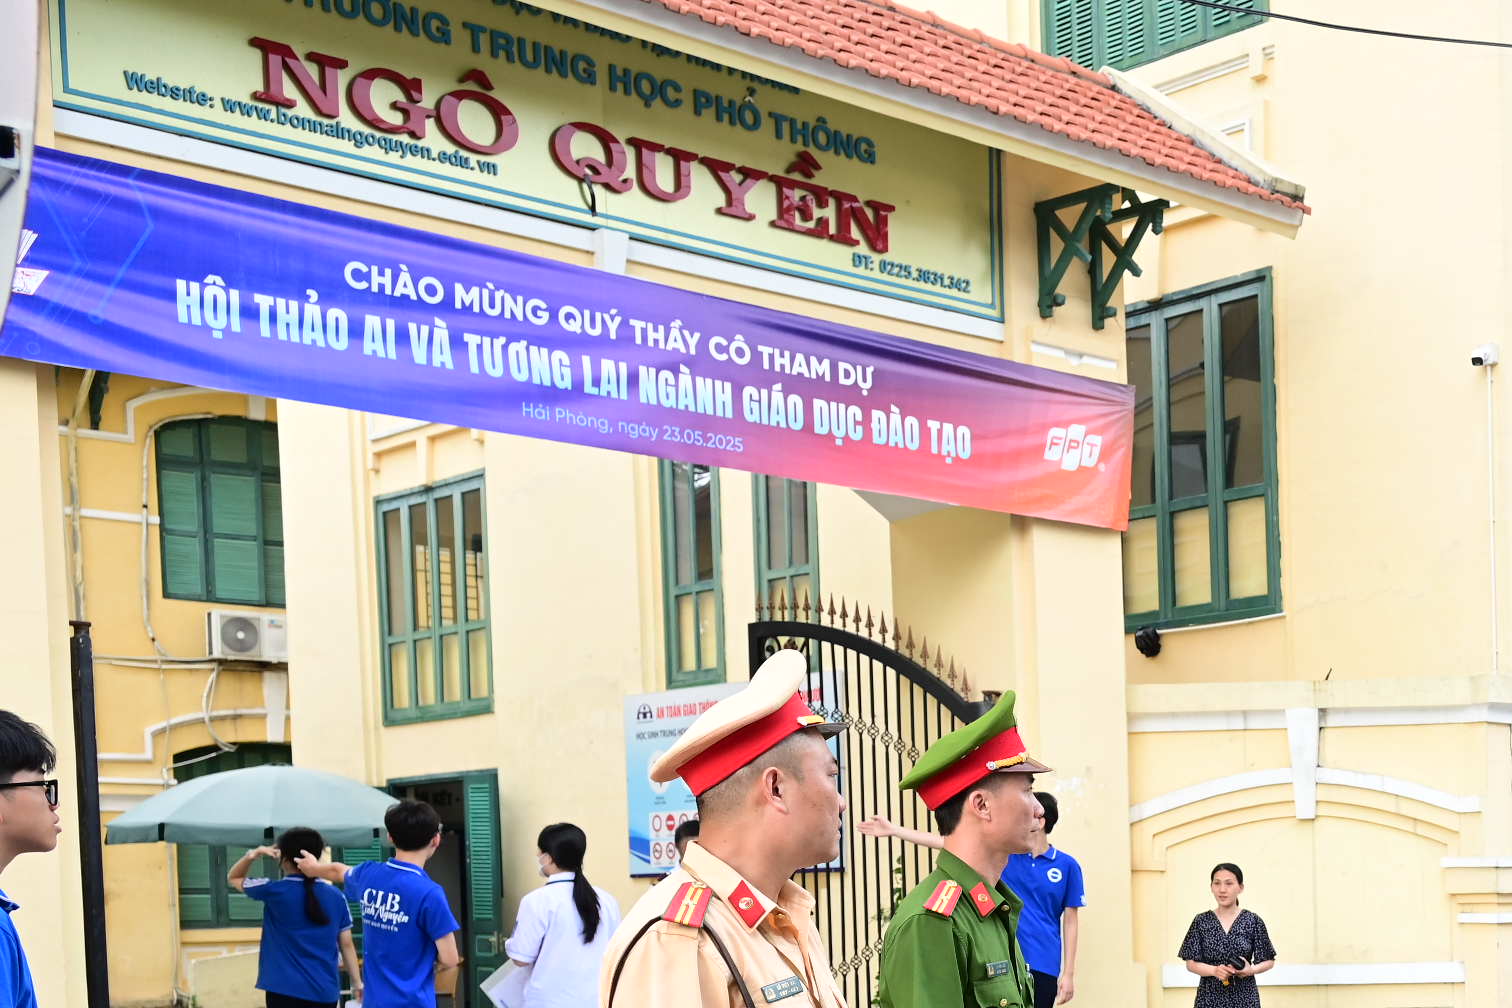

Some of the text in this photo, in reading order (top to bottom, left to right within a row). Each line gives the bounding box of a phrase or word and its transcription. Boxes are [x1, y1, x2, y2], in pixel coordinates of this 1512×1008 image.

[123, 70, 215, 108] Website:
[249, 36, 896, 254] NGÔ QUYỀN
[462, 21, 597, 86] TRUNG
[608, 63, 684, 108] HỌC
[693, 86, 762, 132] PHỐ
[768, 111, 877, 164] THÔNG
[176, 274, 972, 464] HỘI THẢO AI VÀ TƯƠNG LAI NGÀNH GIÁO DỤC ĐÀO TẠO
[344, 261, 874, 396] CHÀO MỪNG QUÝ THẦY CÔ THAM DỰ
[522, 402, 744, 453] Hải Phòng, ngày 23.05.2025
[1045, 429, 1101, 465] FPT
